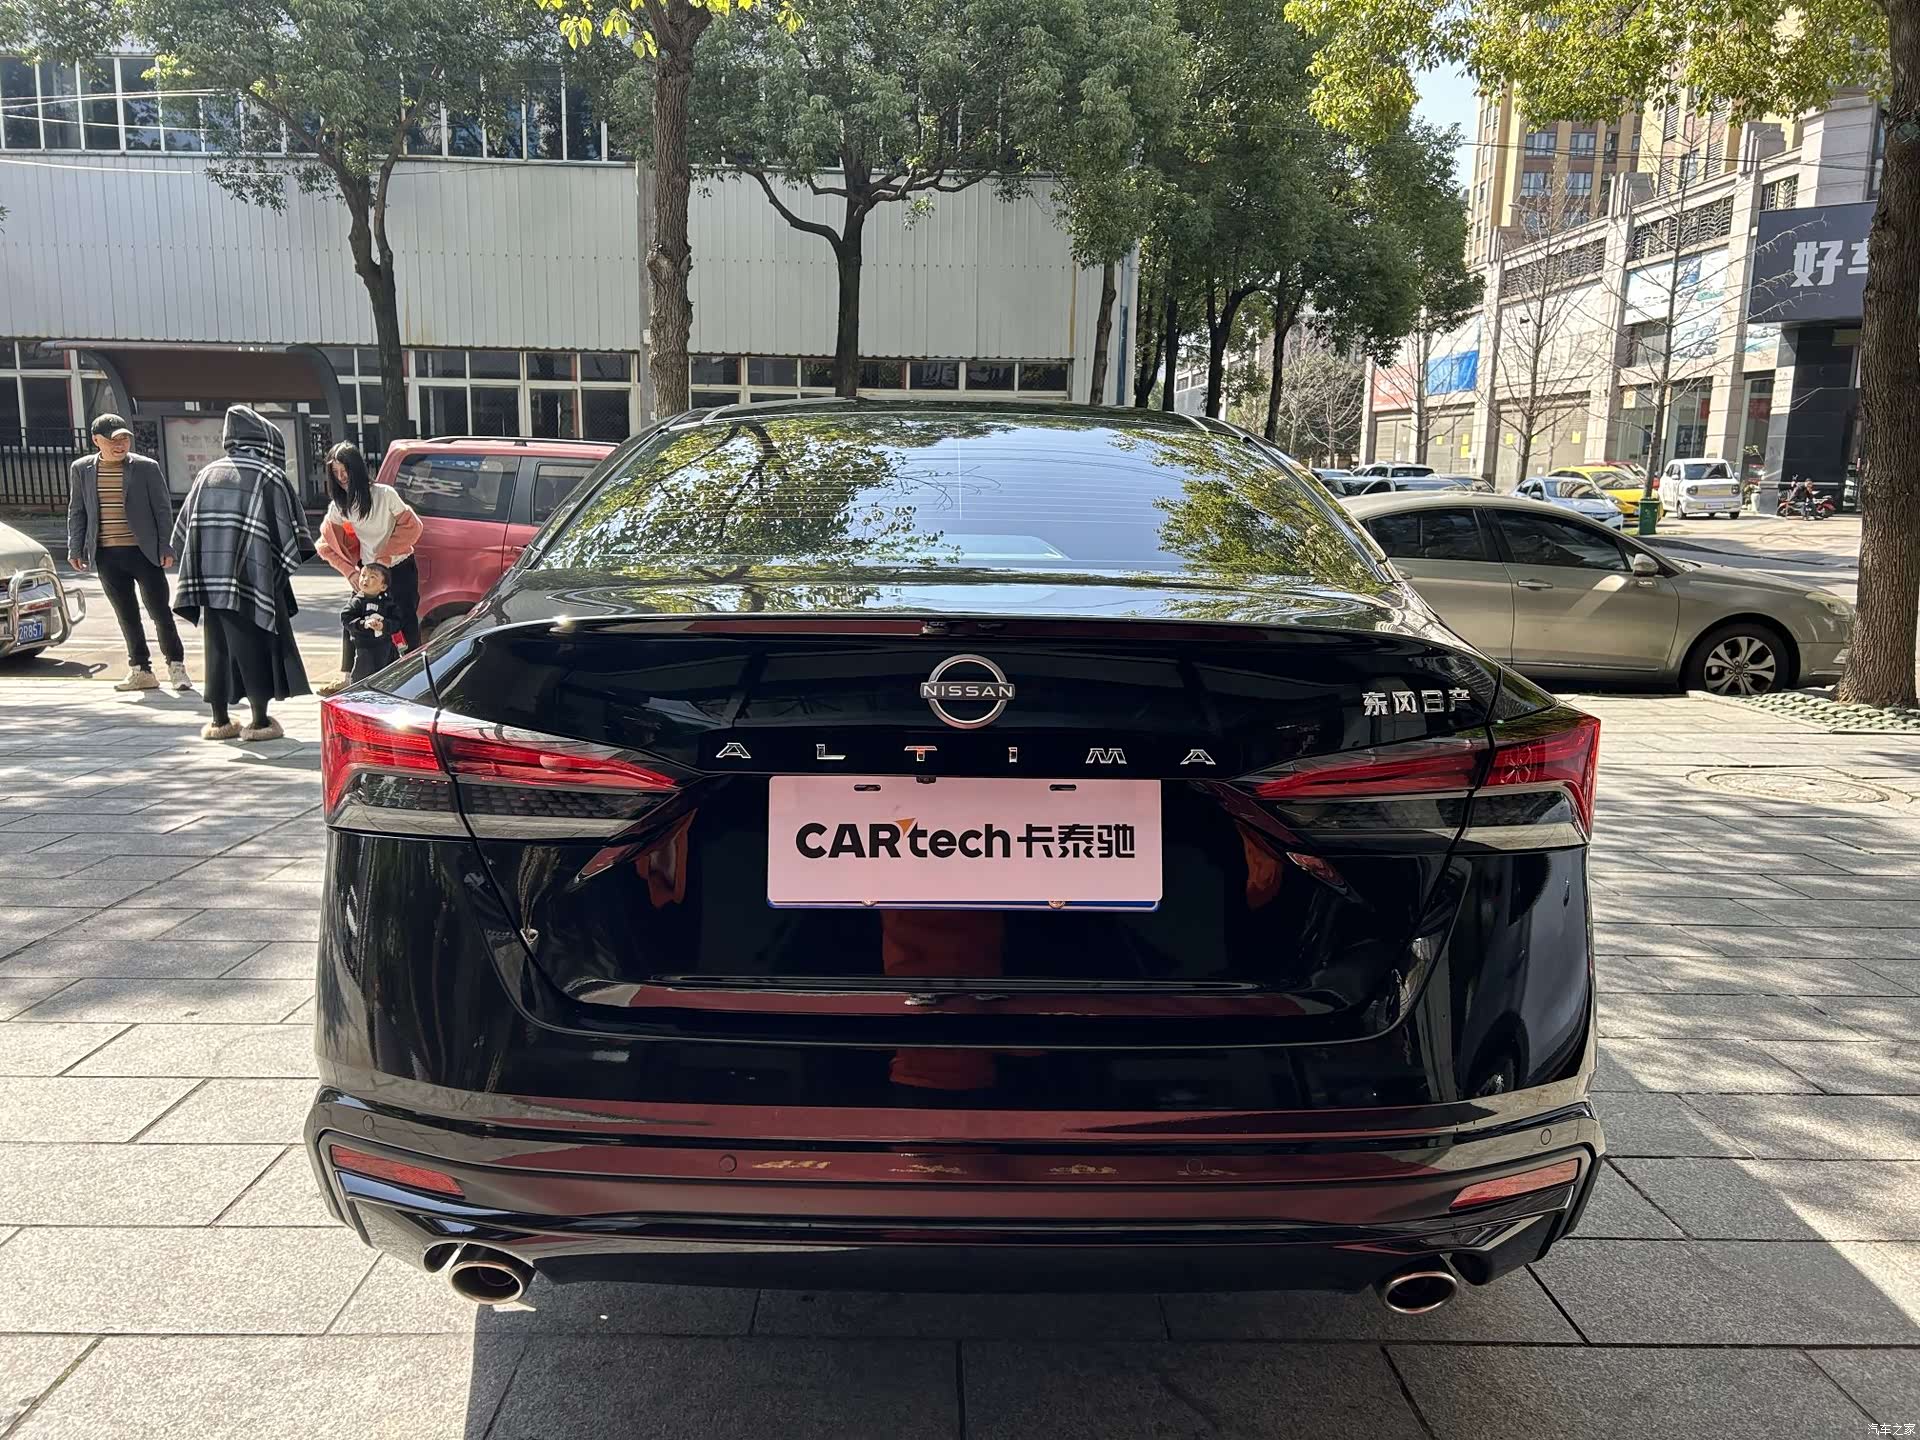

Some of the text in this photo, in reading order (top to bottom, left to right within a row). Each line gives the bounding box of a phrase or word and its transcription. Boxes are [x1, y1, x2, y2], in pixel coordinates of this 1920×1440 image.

[923, 685, 1013, 698] NISSAN
[1361, 687, 1471, 716] 东风日产
[715, 741, 1216, 766] ALTIMA
[1016, 823, 1136, 858] 卡泰驰
